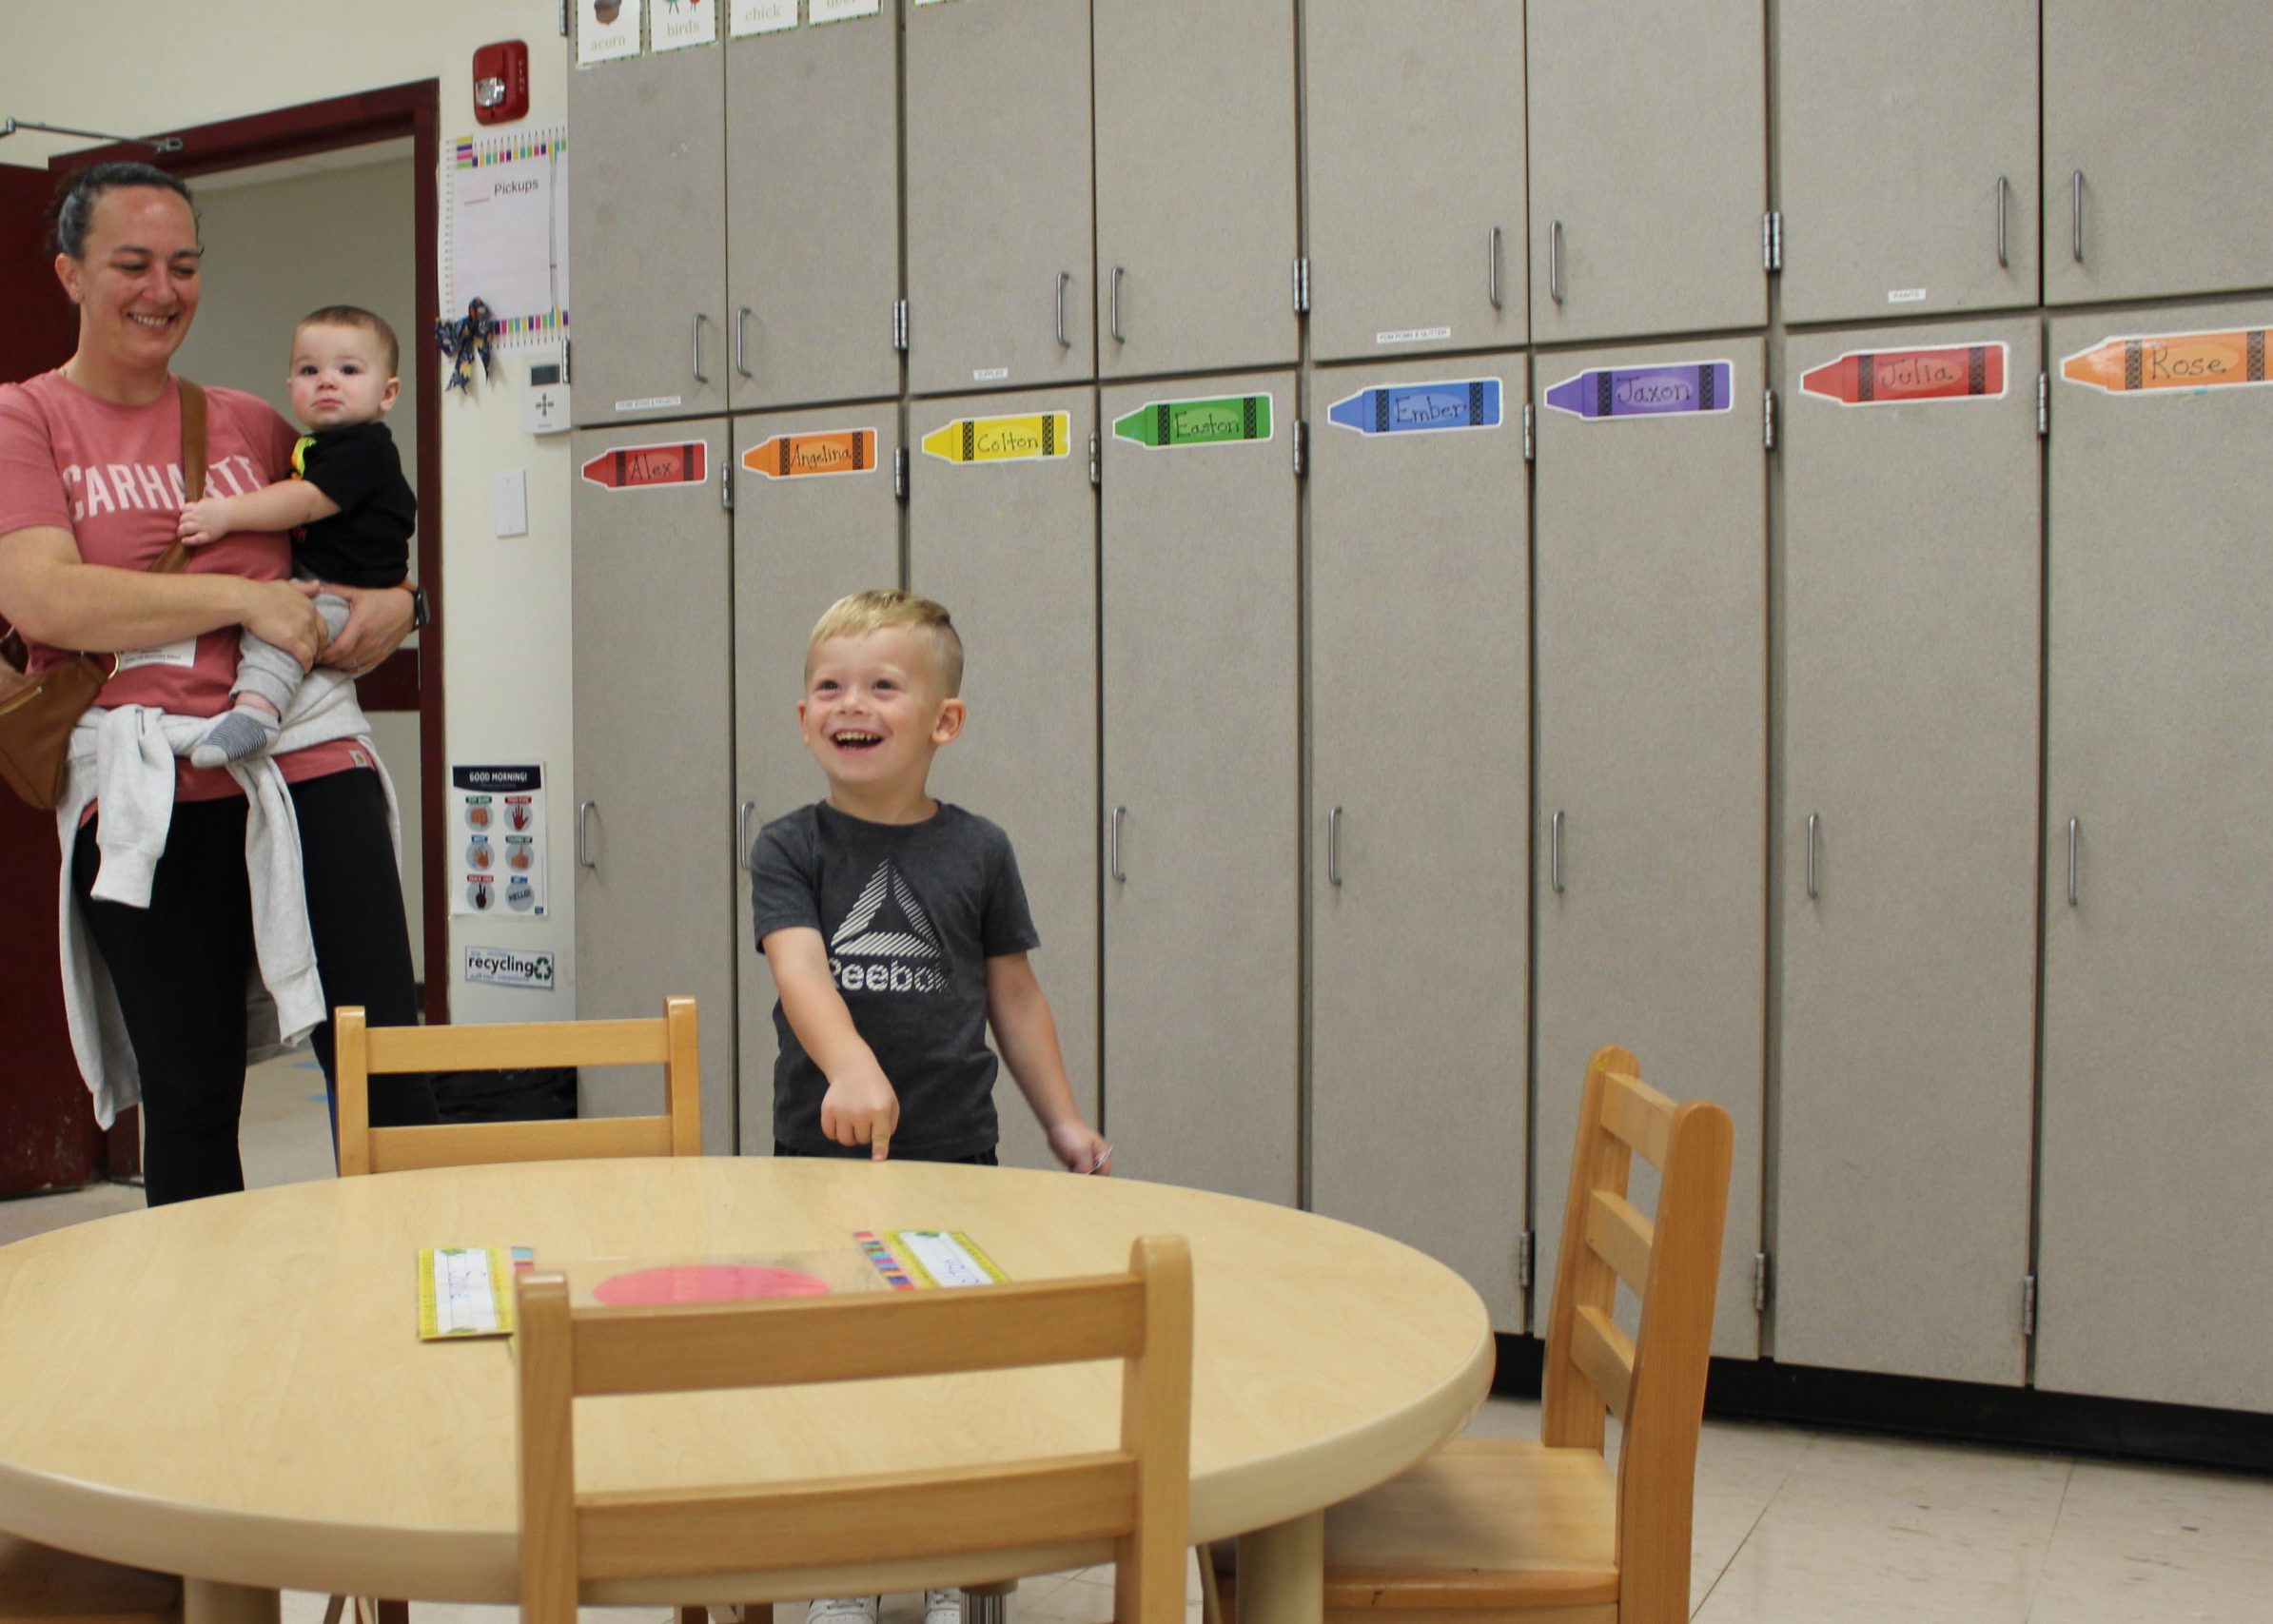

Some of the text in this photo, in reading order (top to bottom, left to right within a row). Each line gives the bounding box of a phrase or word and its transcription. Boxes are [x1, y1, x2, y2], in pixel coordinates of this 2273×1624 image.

[667, 20, 699, 37] birds
[590, 35, 625, 50] acorn
[494, 178, 539, 195] Pickups
[1880, 357, 1952, 386] Julia
[2150, 345, 2226, 381] Rose
[1617, 376, 1691, 403] Jaxon
[1394, 398, 1466, 424] Ember
[1174, 411, 1239, 439] Easton
[977, 432, 1038, 454] Colton
[630, 455, 673, 480] Alex
[790, 444, 852, 470] Angelina
[469, 772, 527, 783] GOOD MORNING!
[508, 889, 531, 902] HELLO!
[468, 955, 534, 977] recycling
